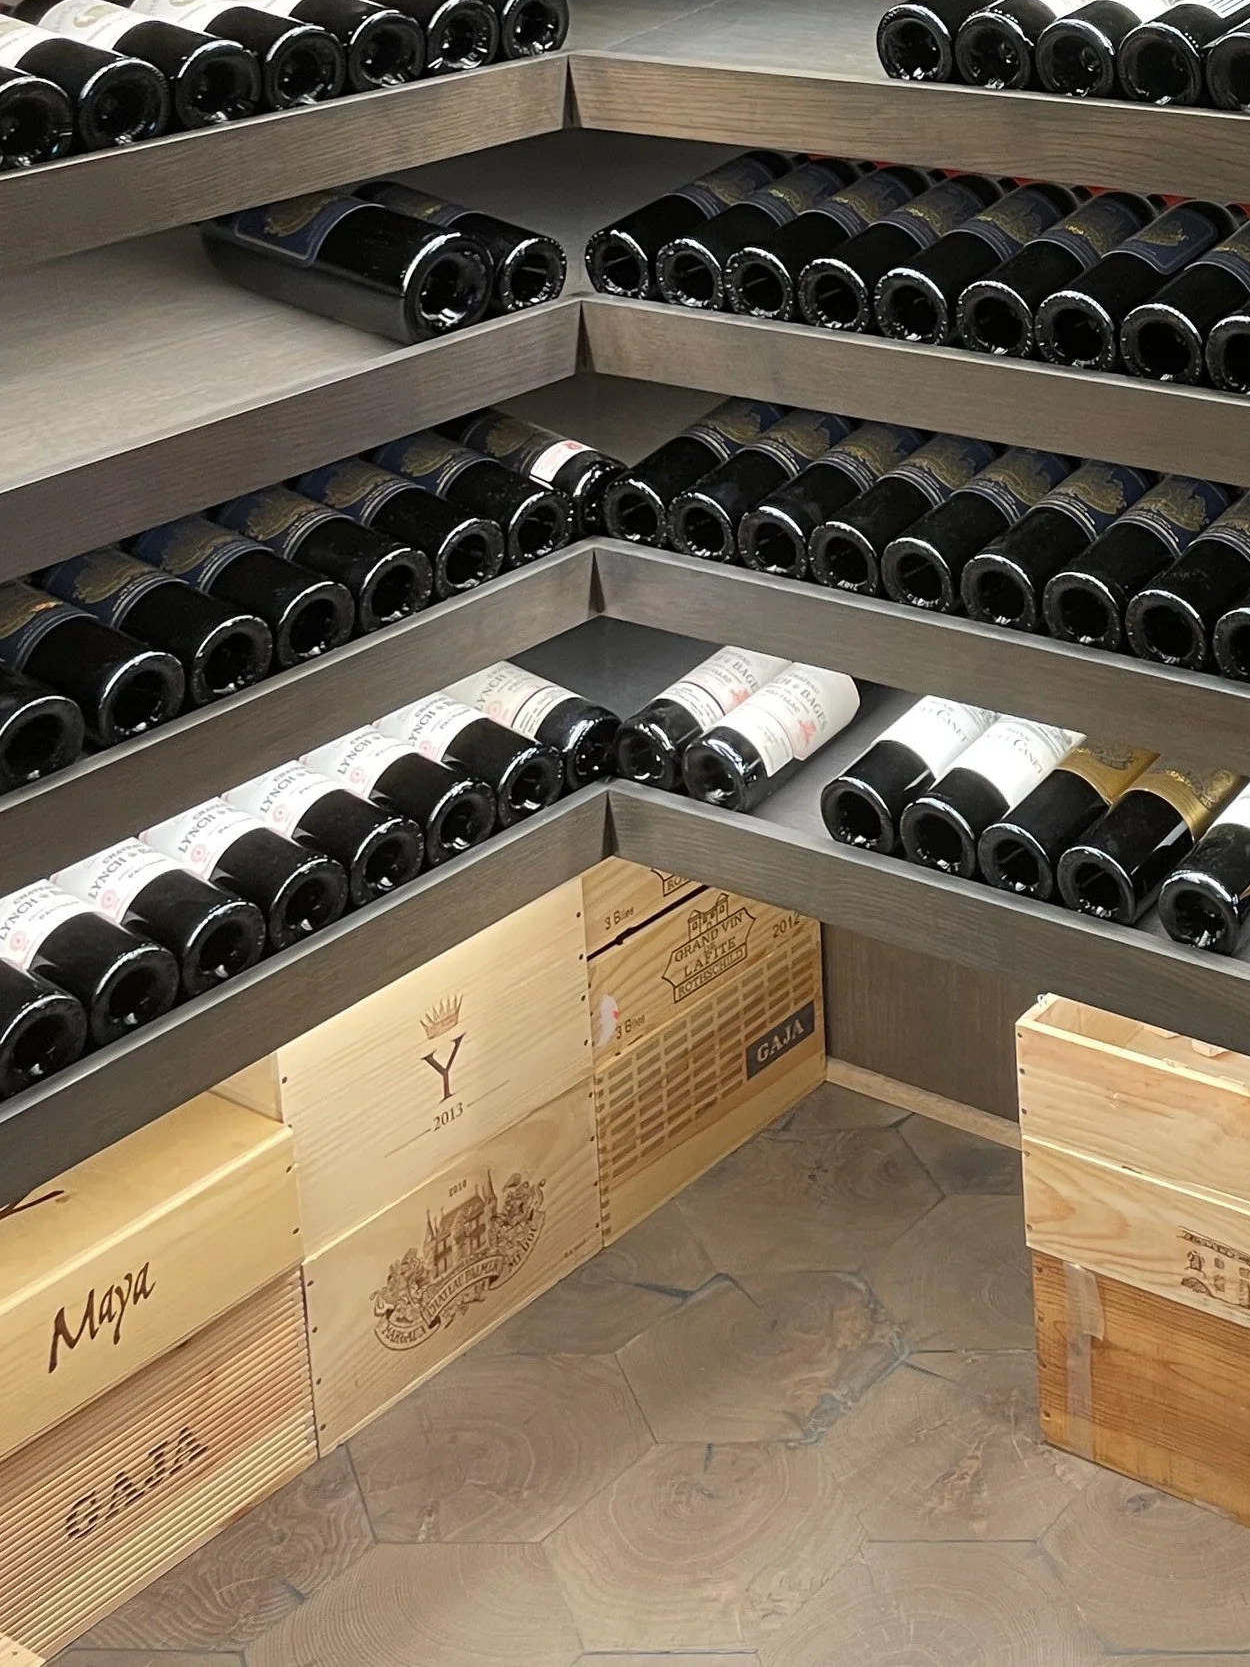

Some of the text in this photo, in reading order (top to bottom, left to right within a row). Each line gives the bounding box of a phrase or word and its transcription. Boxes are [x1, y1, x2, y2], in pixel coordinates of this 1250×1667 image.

[259, 775, 297, 814] LYNCH
[178, 814, 217, 854] LYNCH
[88, 856, 128, 901] LYNCH
[674, 912, 744, 963] GRAND VIN
[683, 934, 737, 978] LAFITE
[677, 948, 745, 997] ROTHSCHILD
[756, 1018, 806, 1063] GAJA
[421, 1031, 467, 1104] Y
[432, 1101, 464, 1132] 2013
[48, 1262, 156, 1374] Maya
[65, 1426, 208, 1540] GAJA
